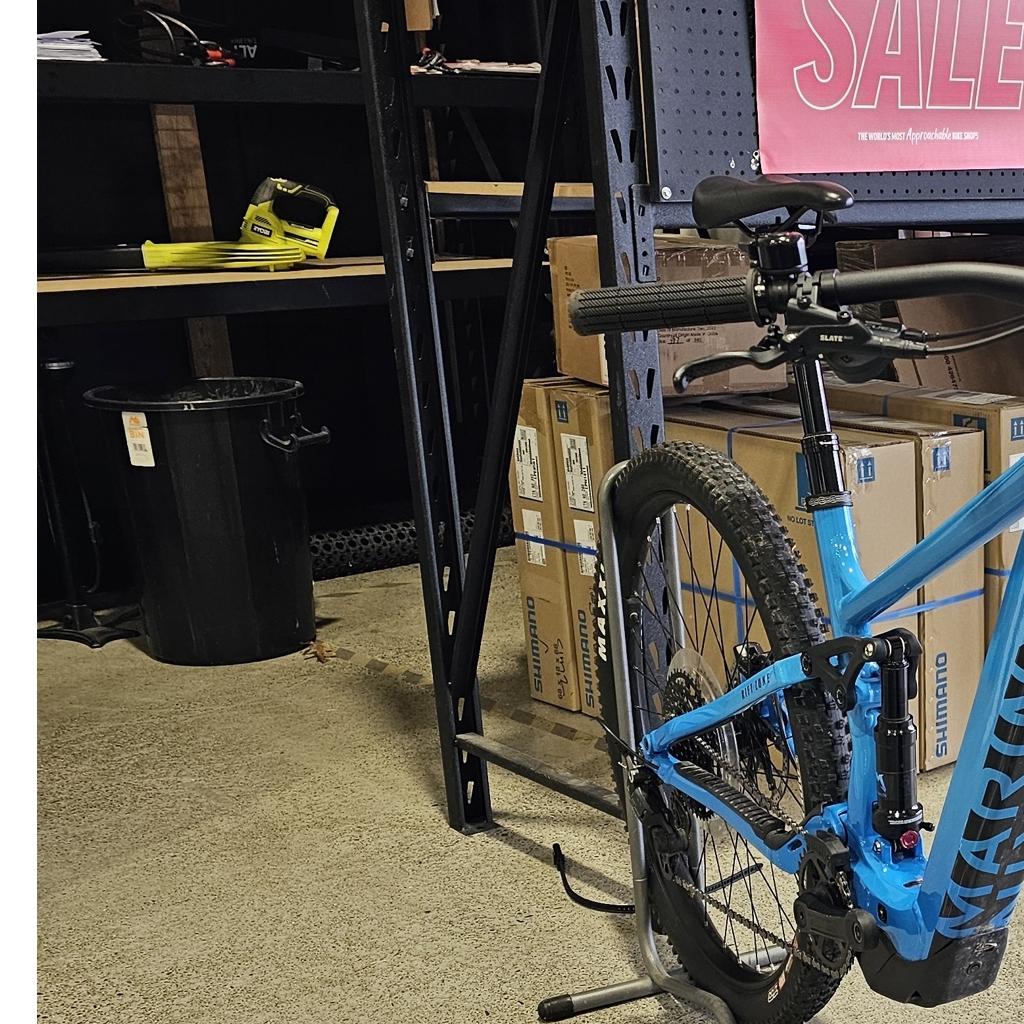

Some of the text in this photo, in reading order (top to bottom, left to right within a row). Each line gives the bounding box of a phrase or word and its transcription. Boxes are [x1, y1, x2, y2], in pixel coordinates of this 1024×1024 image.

[794, 0, 1024, 110] SALE
[858, 131, 868, 140] THE
[868, 131, 891, 140] WORLD'S
[892, 131, 905, 140] MOST
[906, 127, 951, 145] Approachable
[819, 334, 843, 342] SLATE
[526, 596, 543, 694] SHIMANO
[577, 609, 595, 708] SHIMANO
[935, 651, 948, 758] SHIMANO
